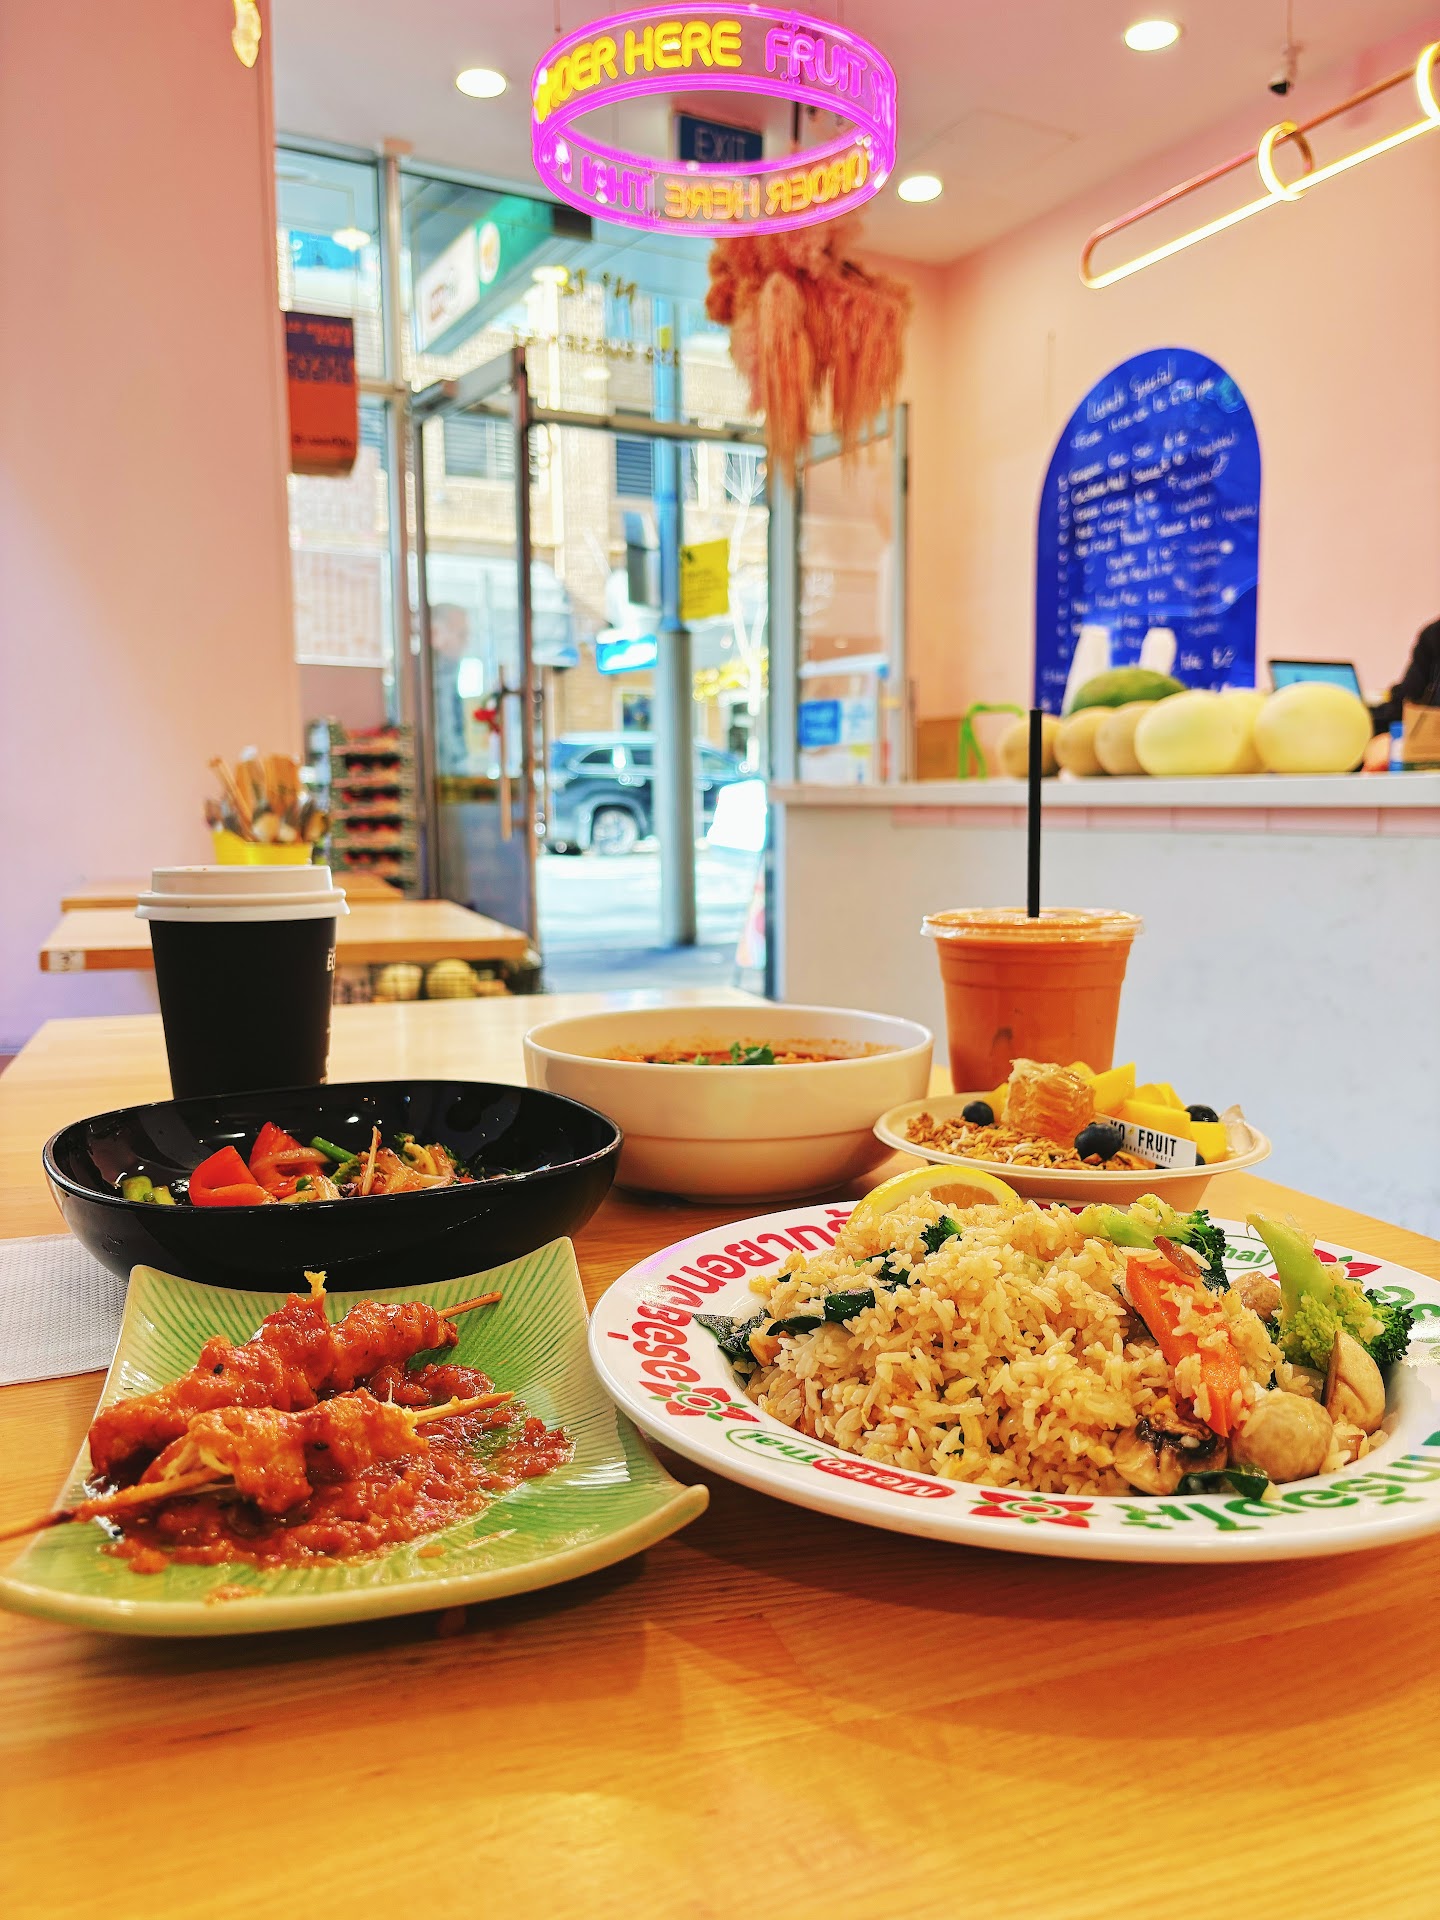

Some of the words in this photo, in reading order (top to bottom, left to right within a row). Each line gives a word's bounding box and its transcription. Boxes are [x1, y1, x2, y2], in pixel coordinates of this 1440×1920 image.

[624, 20, 742, 75] HERE
[765, 27, 868, 98] FRUIT
[694, 126, 746, 162] EXIT
[1138, 1128, 1177, 1157] FRUIT
[1224, 1244, 1270, 1265] hai
[737, 1433, 825, 1463] Thai
[821, 1458, 947, 1498] Metro
